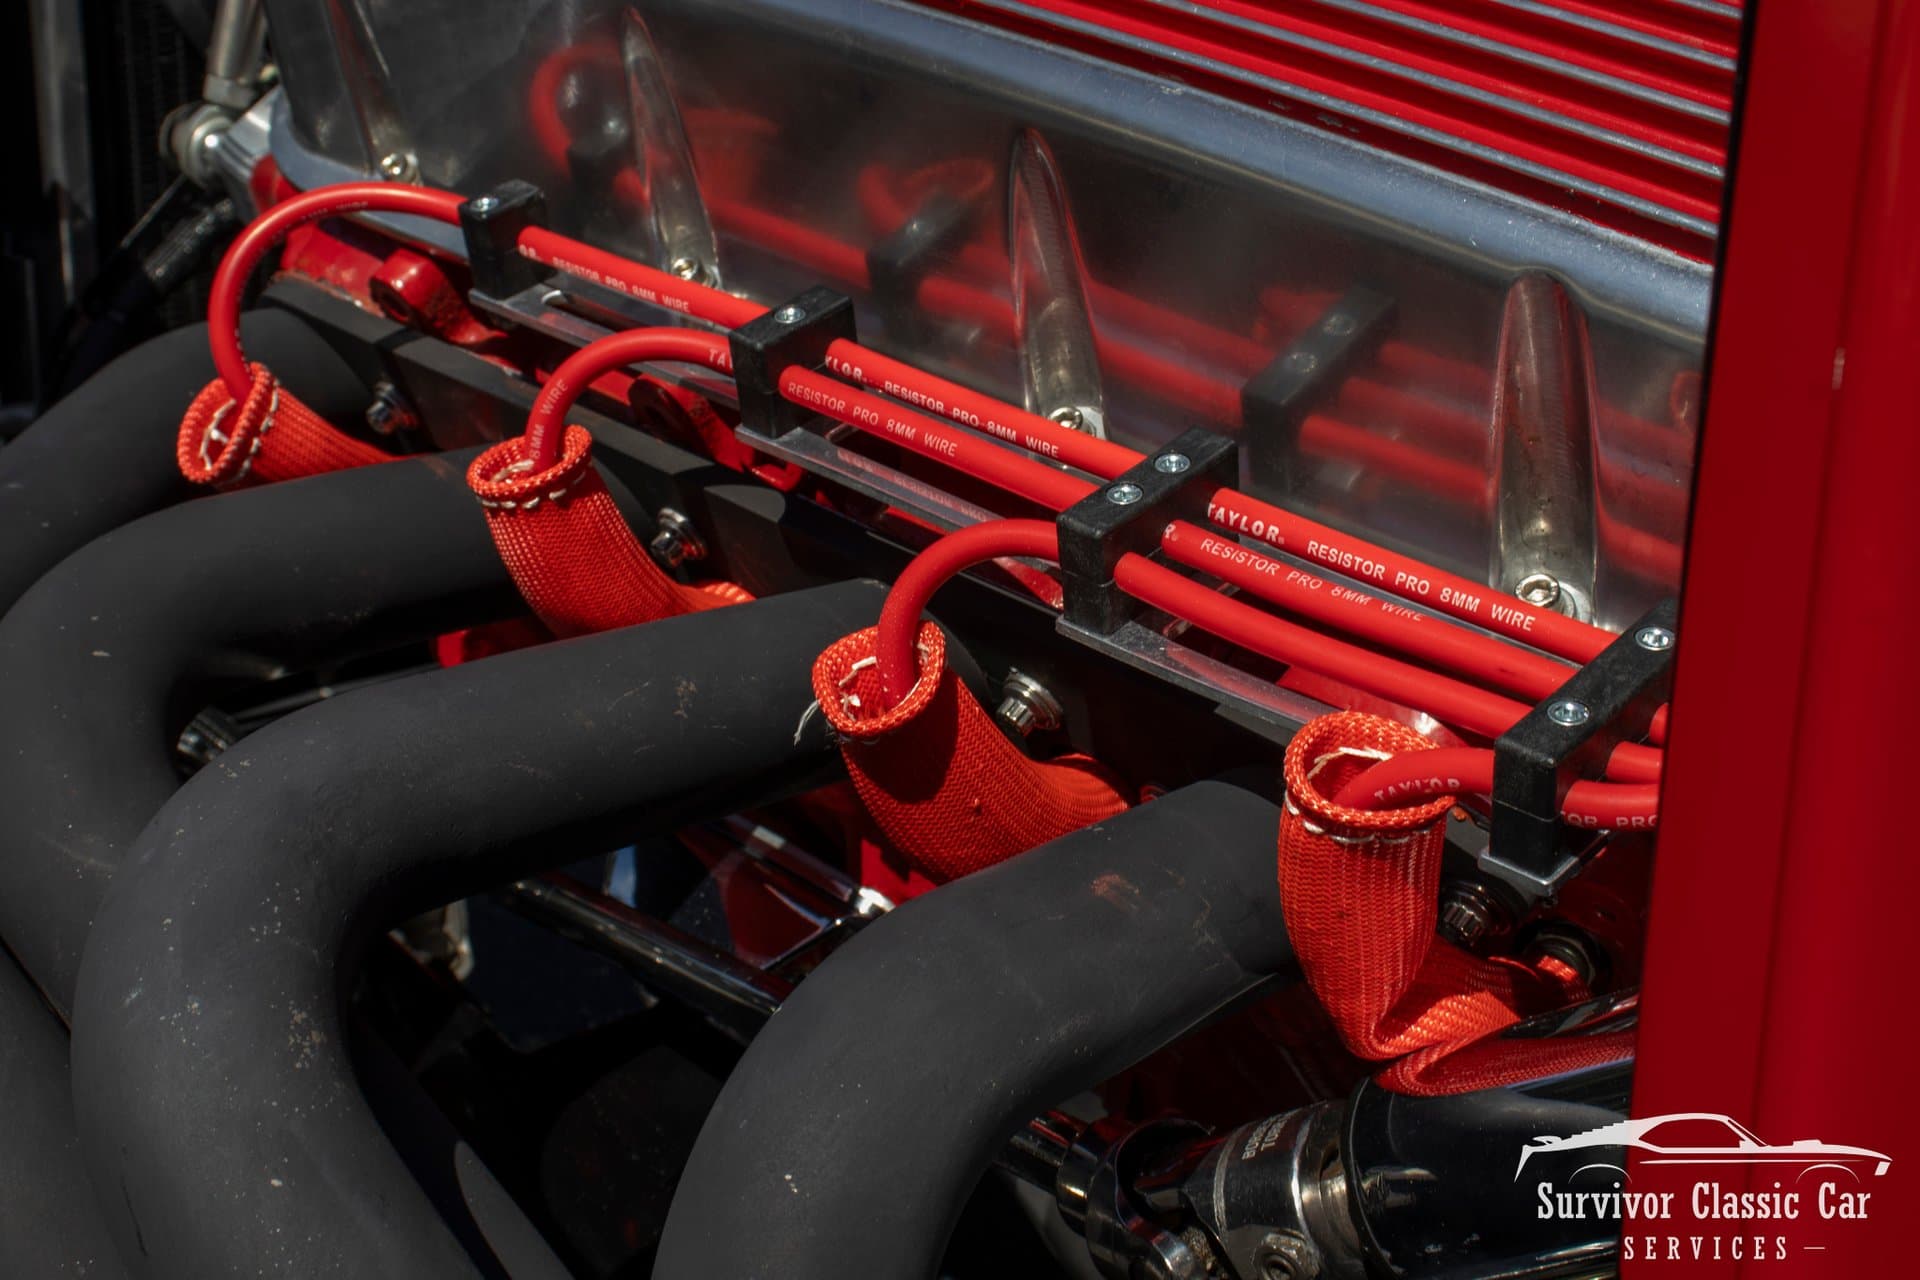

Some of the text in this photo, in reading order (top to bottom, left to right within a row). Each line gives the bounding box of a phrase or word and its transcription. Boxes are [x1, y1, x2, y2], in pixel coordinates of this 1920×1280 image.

[605, 275, 627, 292] PRO
[661, 293, 691, 313] WIRE
[528, 379, 568, 459] 8MM WIRE
[788, 382, 958, 457] RESISTOR PRO 8MM WIRE
[884, 380, 945, 413] RESISTOR
[952, 407, 979, 428] PRO
[987, 420, 1017, 442] 8MM
[1025, 434, 1060, 458] WIRE
[1200, 538, 1281, 576] RESISTOR
[1286, 570, 1323, 590] PRO
[1331, 586, 1373, 606] 8MM
[1381, 601, 1426, 622] WIRE
[1307, 540, 1386, 580] RESISTOR
[1395, 571, 1430, 595] PRO
[1440, 587, 1481, 613] 8MM
[1491, 603, 1536, 632] WIRE
